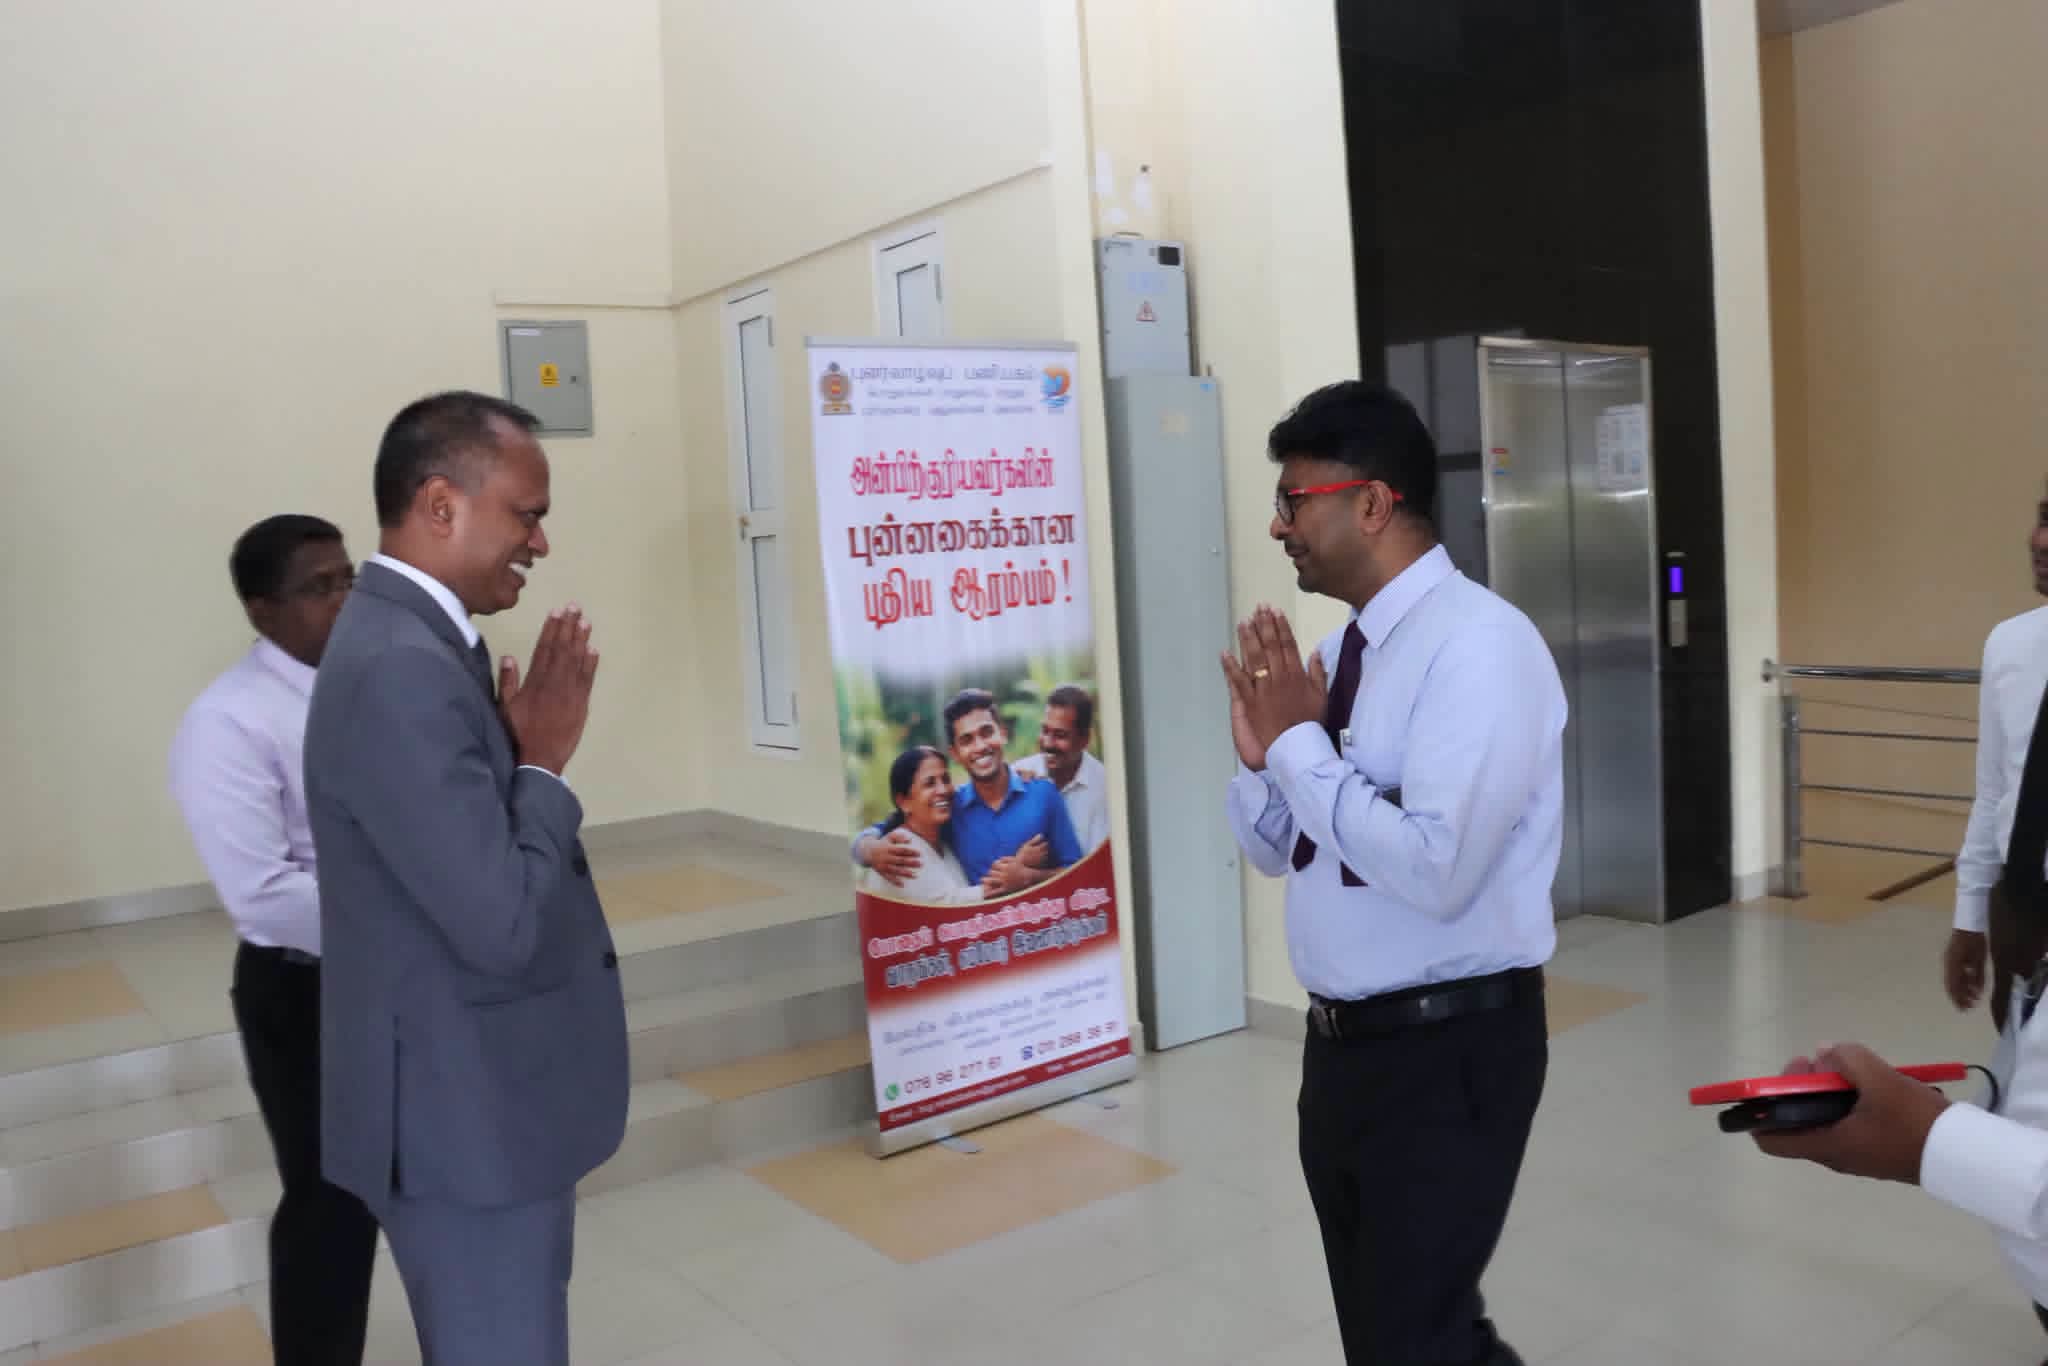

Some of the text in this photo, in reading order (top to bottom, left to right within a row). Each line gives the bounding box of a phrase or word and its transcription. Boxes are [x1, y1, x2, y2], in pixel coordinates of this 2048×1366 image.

[851, 448, 1055, 500] அன்பிற்குரியவர்களின்
[848, 507, 1076, 567] புன்னகைக்கான
[863, 557, 1073, 631] புதிய ஆரம்பம்!
